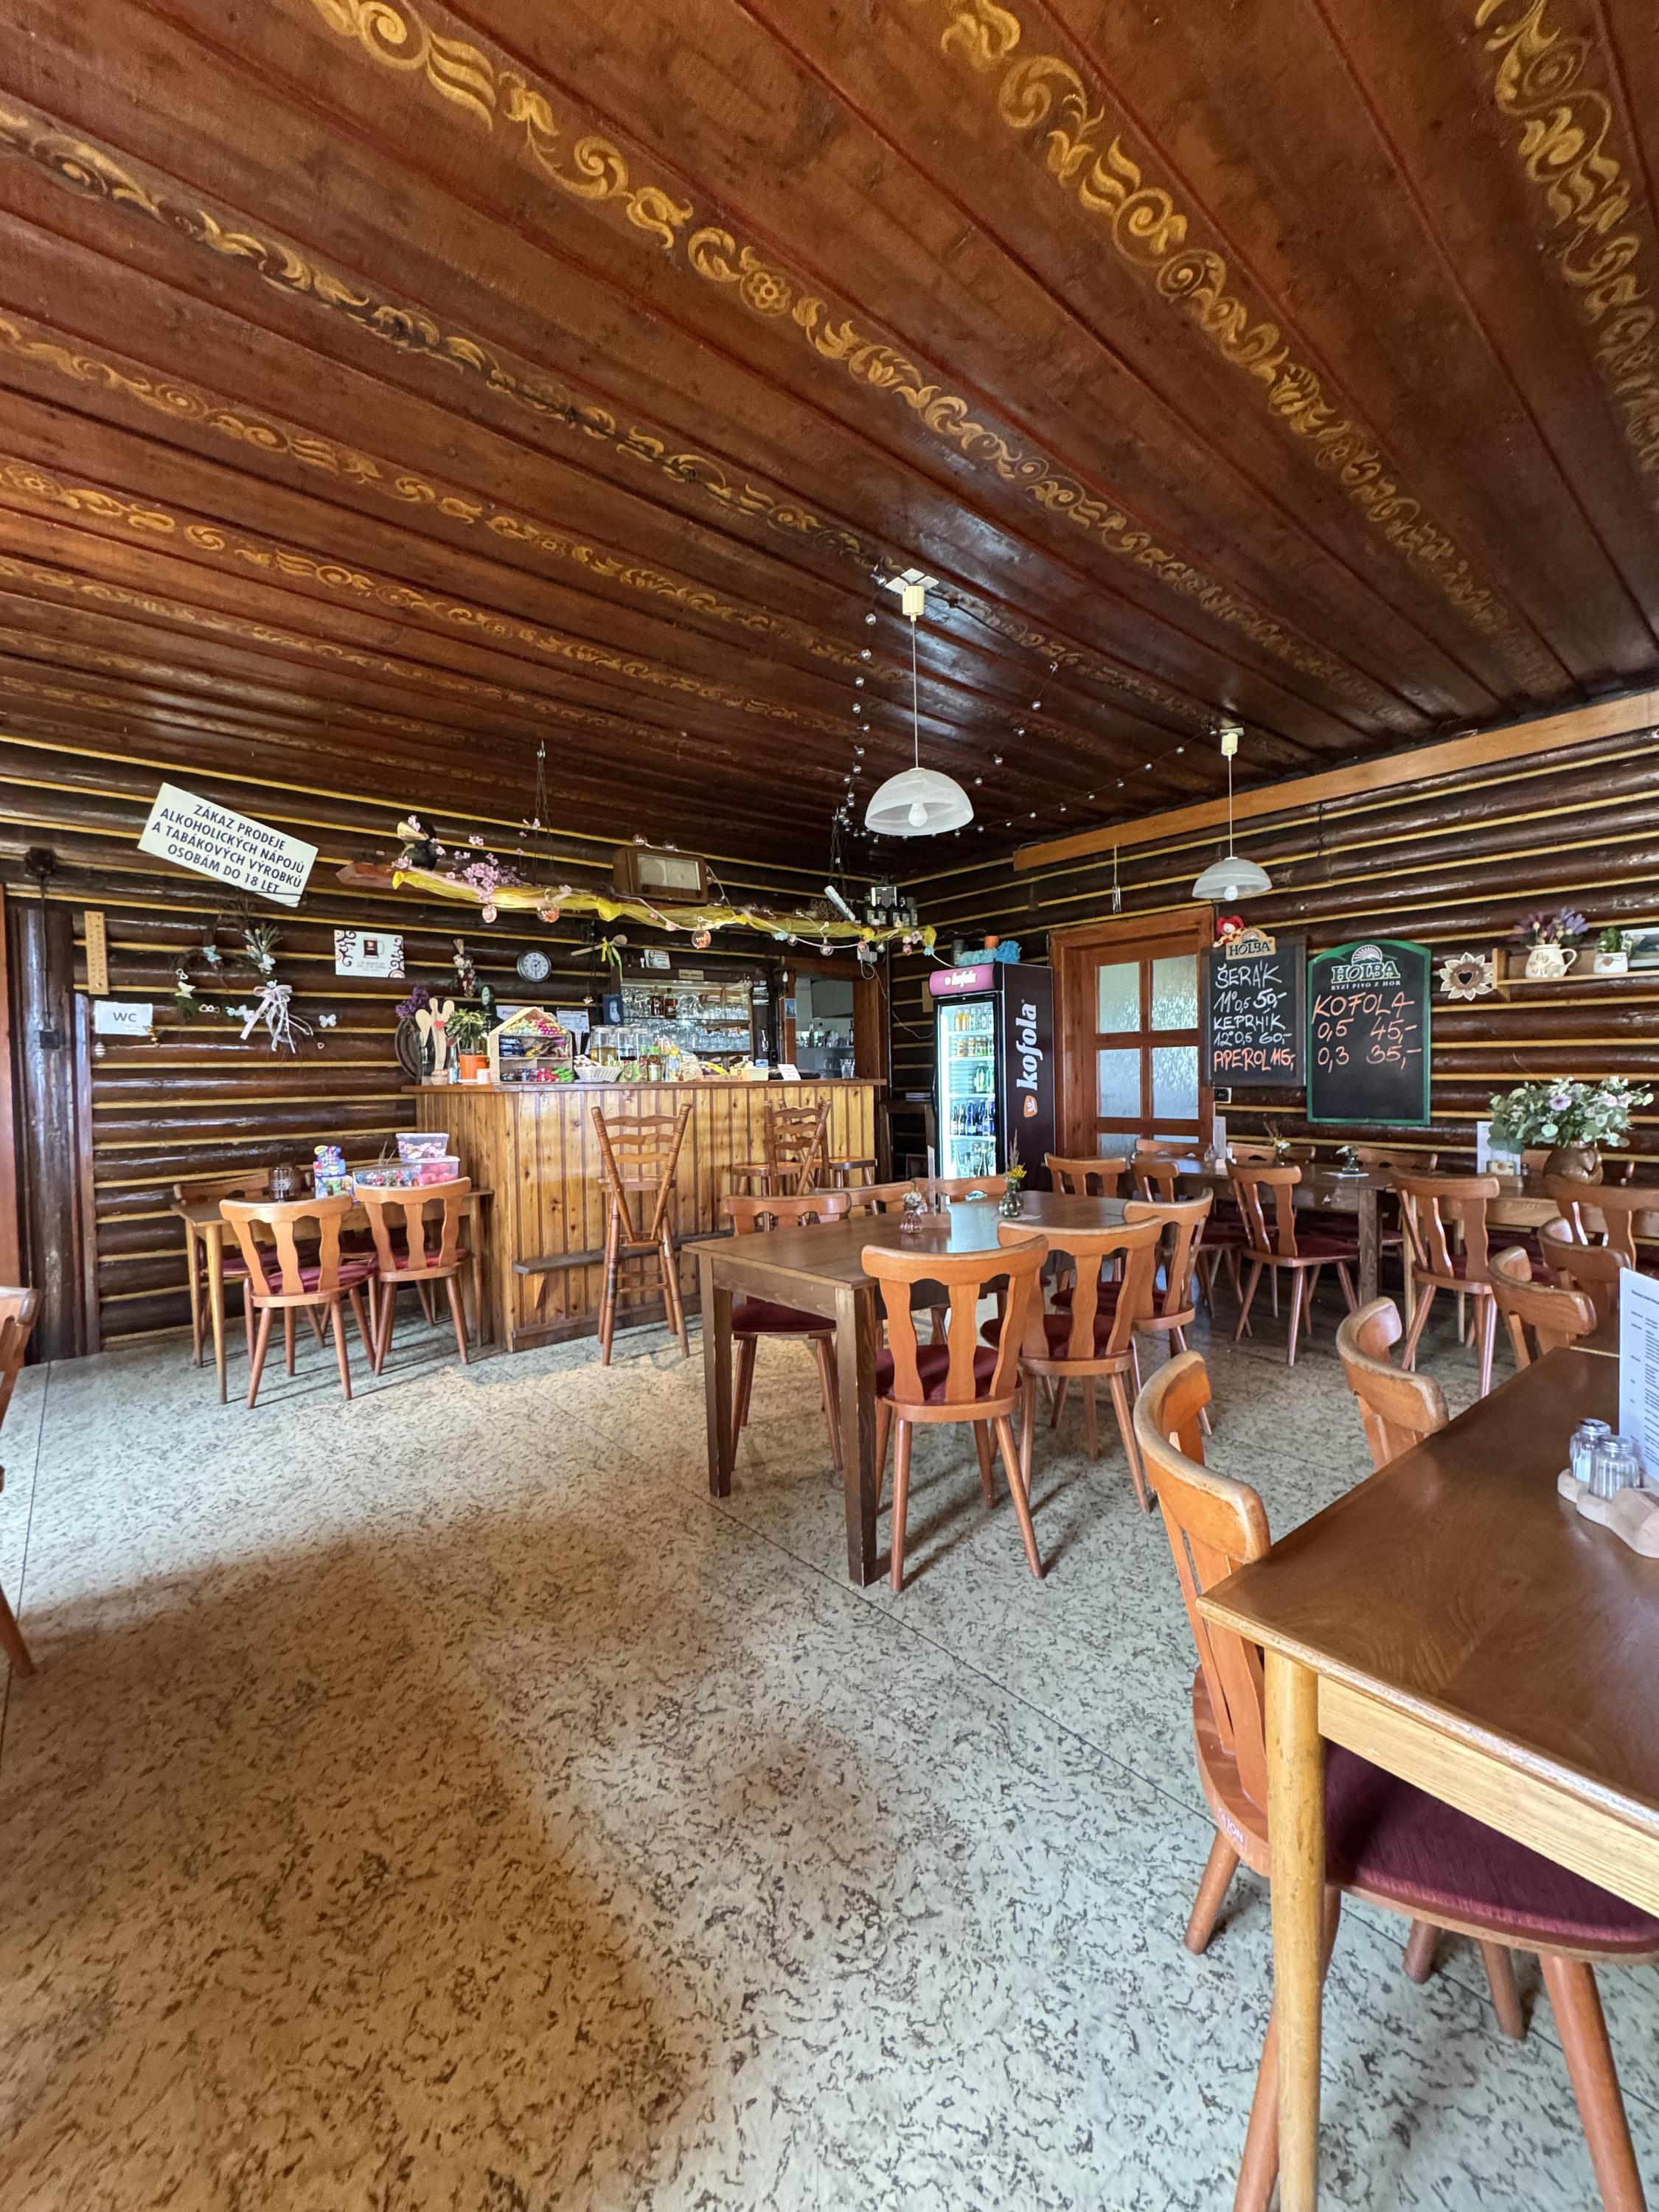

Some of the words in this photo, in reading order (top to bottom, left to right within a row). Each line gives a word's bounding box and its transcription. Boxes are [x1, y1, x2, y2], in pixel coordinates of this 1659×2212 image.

[160, 807, 258, 855] ALKOHOLICKÝCH
[260, 848, 305, 874] NÁPOJŮ
[193, 804, 236, 830] ZÁKAZ
[237, 822, 286, 851] PRODEJE
[152, 821, 161, 833] A
[165, 825, 245, 866] TABÁKOVÝCH
[249, 858, 302, 888] VÝROBKŮ
[167, 844, 220, 872] OSOBÁM
[223, 865, 241, 880] DO
[246, 873, 258, 886] 18
[260, 880, 280, 894] LET
[1228, 941, 1271, 956] HOLBA
[1215, 959, 1282, 989] ŠERÁK
[1330, 960, 1401, 984] HOLBA
[113, 1012, 138, 1023] WC
[1234, 997, 1252, 1013] 0,5
[1311, 991, 1416, 1025] KOFOLA
[1234, 1031, 1253, 1046] 0,5
[1318, 1018, 1354, 1042] 0,5
[1015, 1003, 1043, 1091] kofola
[1214, 1047, 1272, 1072] APEROL
[1318, 1046, 1350, 1074] 0,3
